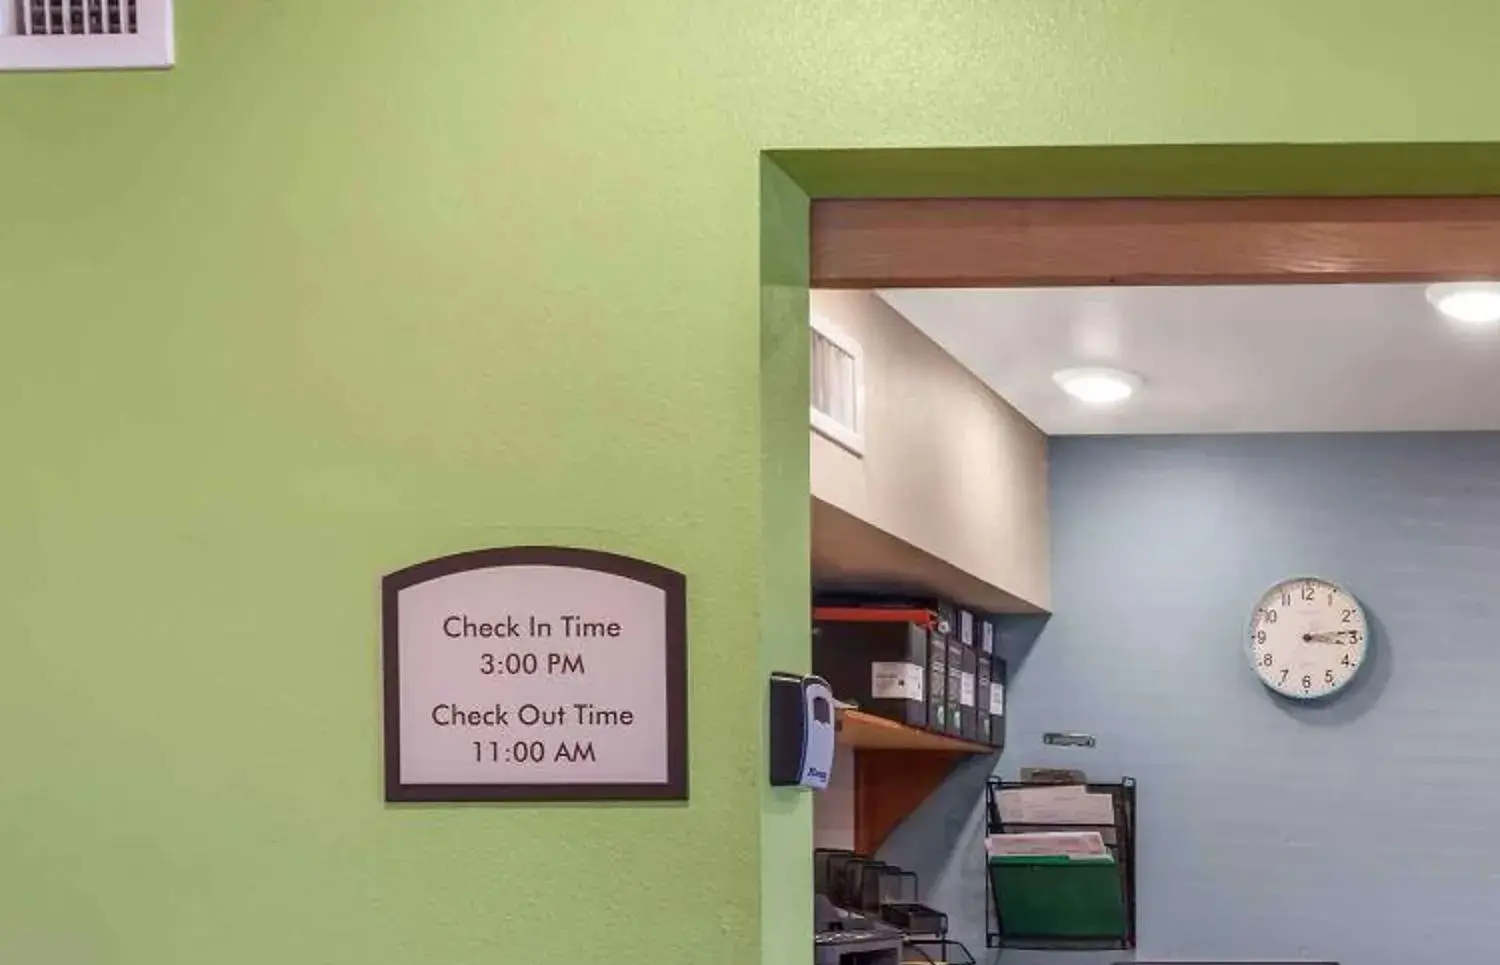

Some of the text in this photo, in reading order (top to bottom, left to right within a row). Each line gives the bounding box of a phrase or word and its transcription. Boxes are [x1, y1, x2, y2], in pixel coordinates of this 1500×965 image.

[1281, 593, 1291, 606] 11
[1301, 584, 1315, 601] 12
[1341, 609, 1351, 623] 2
[443, 615, 622, 638] Check In Time
[1257, 630, 1267, 645] 9
[1348, 630, 1359, 645] 3
[479, 653, 585, 675] 3:00 PM
[1263, 653, 1273, 667] 8
[1341, 653, 1350, 668] 4
[1280, 669, 1289, 682] 7
[1302, 675, 1311, 689] 6
[1325, 669, 1334, 683] 5
[431, 703, 634, 726] Check Out Time
[472, 741, 597, 763] 11:00 AM
